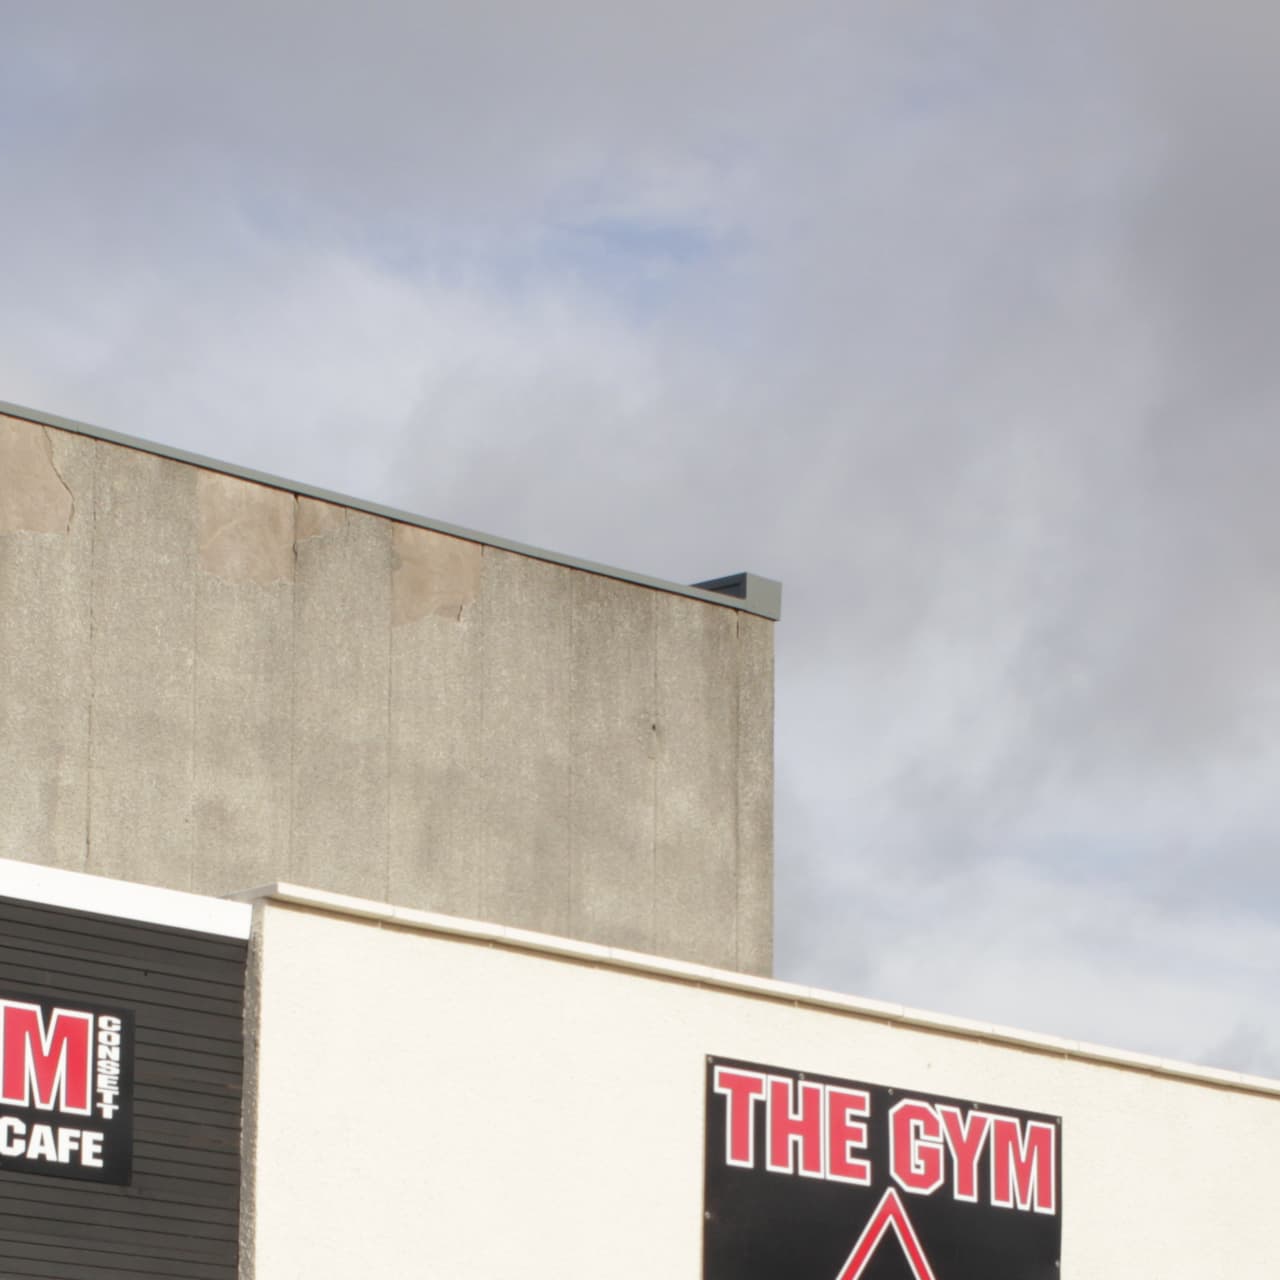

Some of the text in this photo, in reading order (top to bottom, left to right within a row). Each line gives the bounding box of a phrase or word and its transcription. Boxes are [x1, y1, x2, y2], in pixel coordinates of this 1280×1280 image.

[96, 1015, 122, 1119] CONSETT
[714, 1065, 1056, 1215] THE GYM
